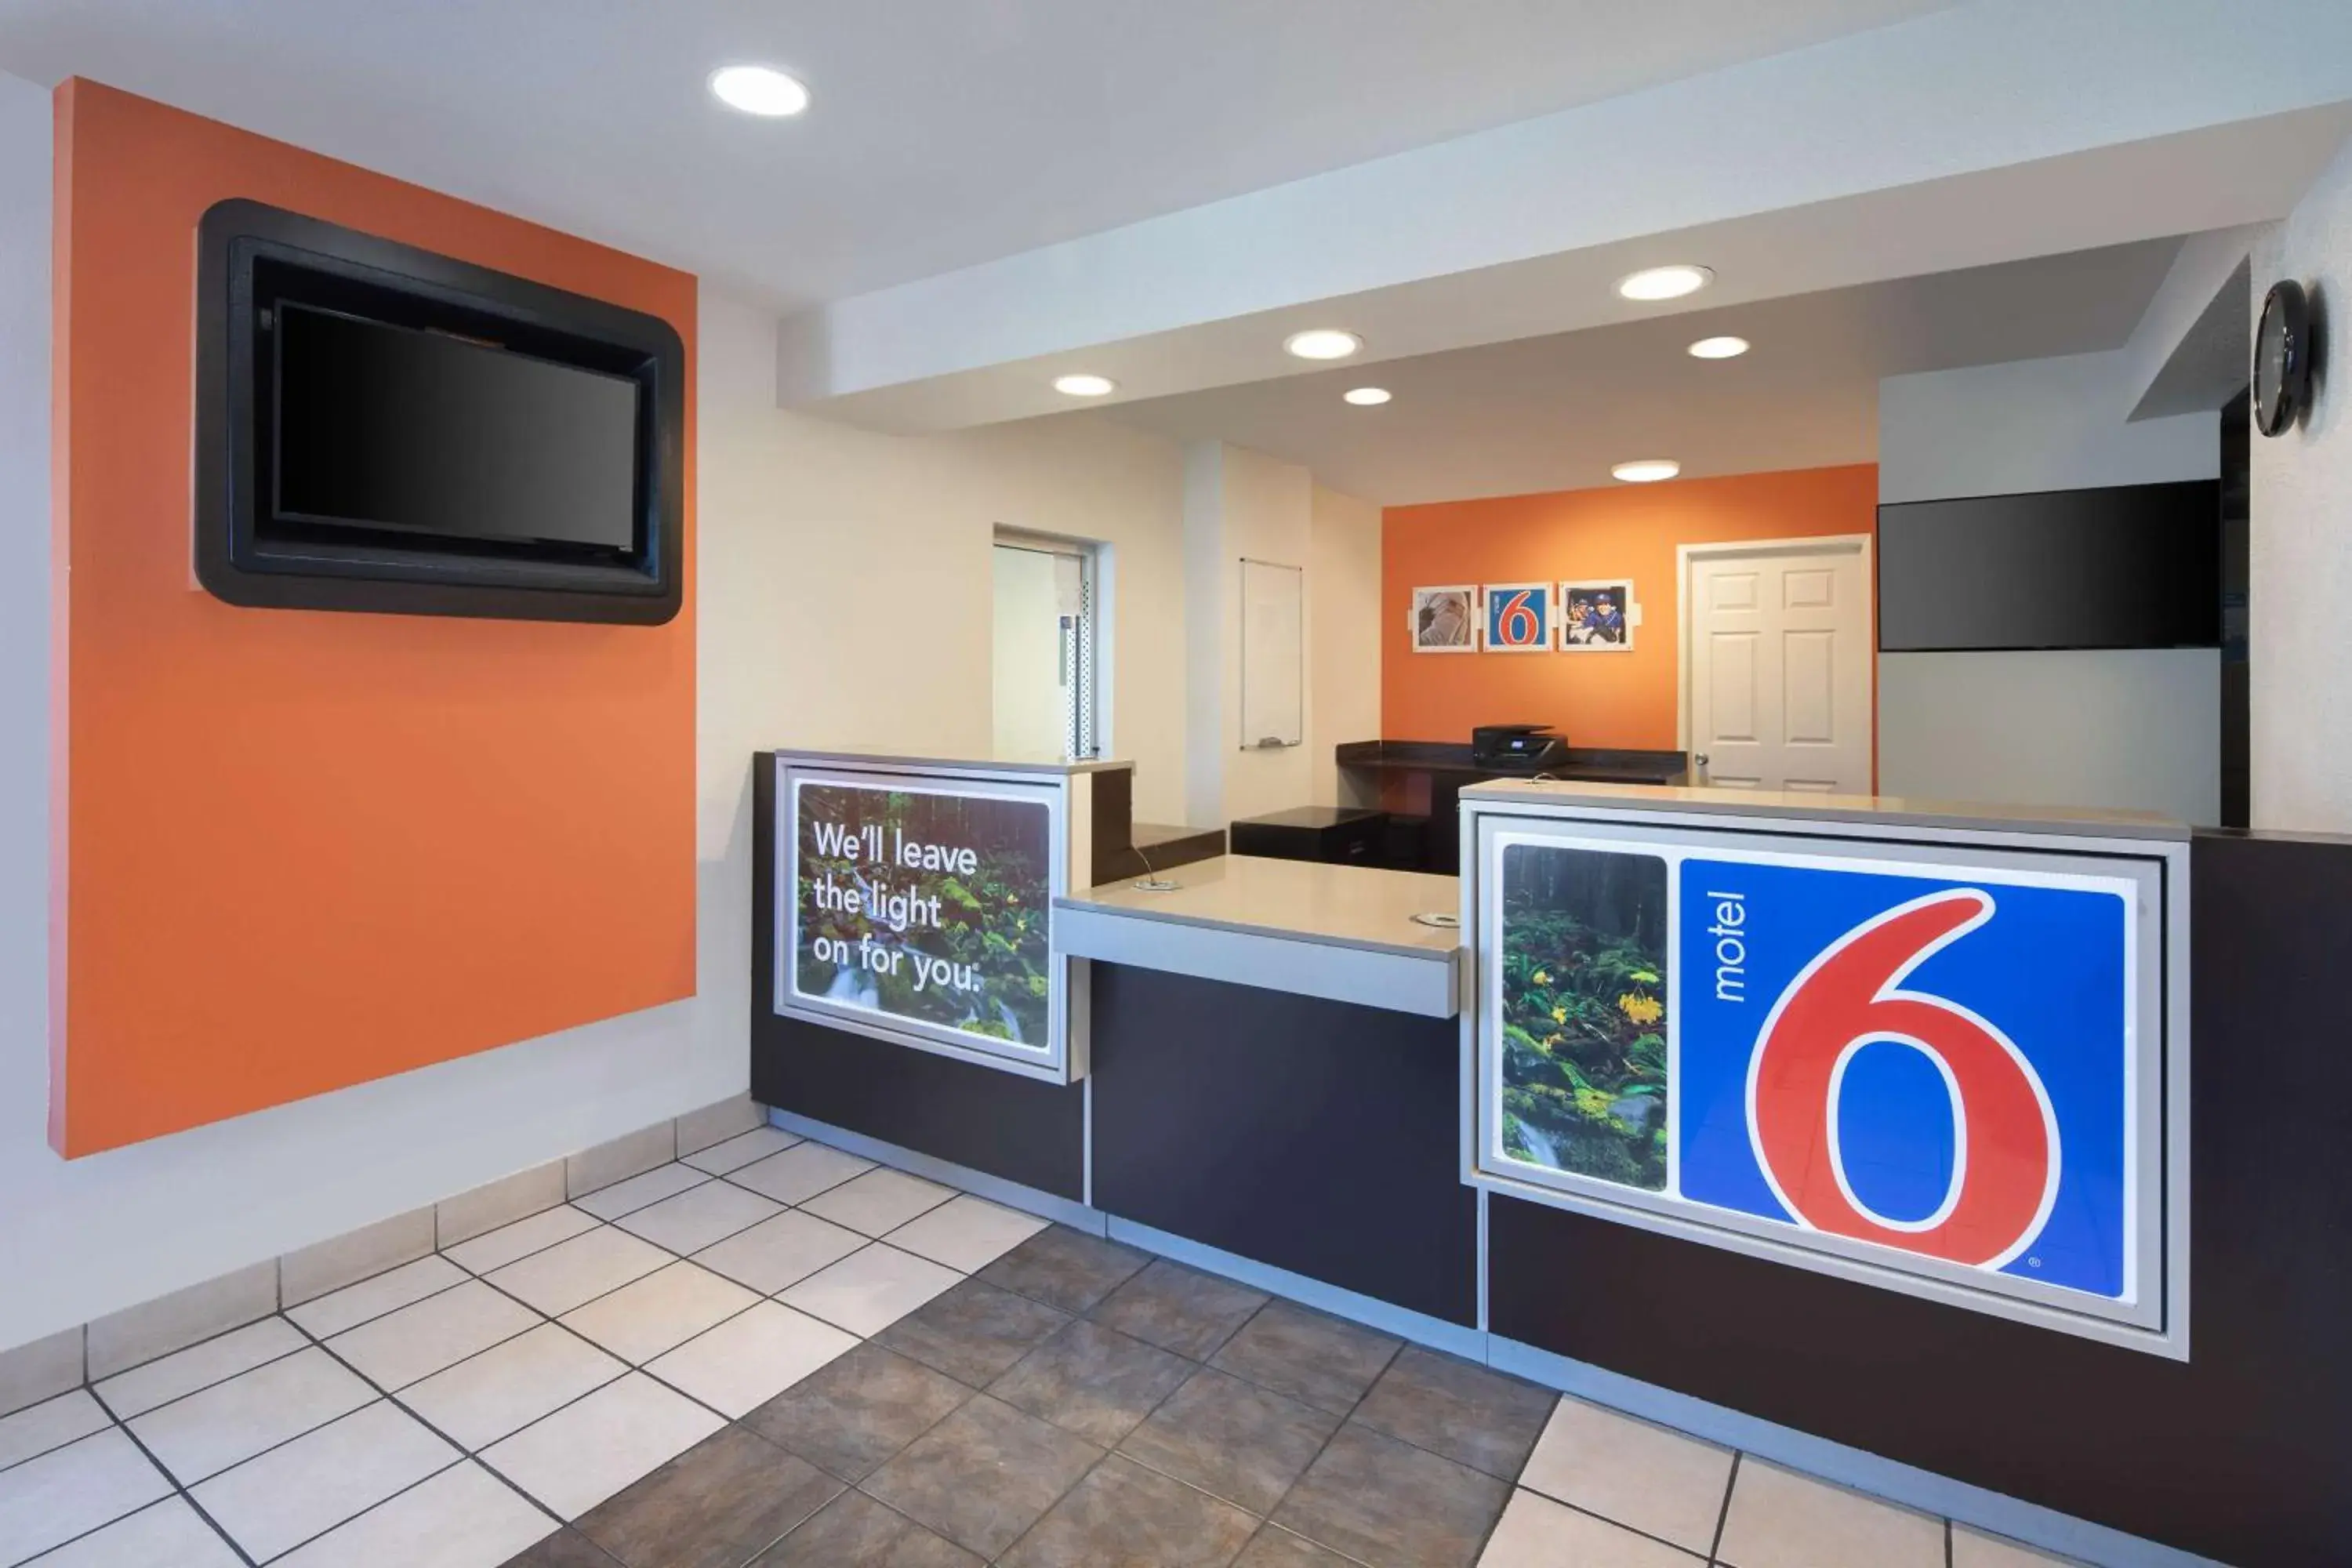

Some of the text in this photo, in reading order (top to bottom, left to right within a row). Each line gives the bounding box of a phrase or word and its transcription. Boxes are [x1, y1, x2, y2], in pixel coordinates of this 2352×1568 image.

[1499, 590, 1539, 645] 6
[813, 822, 978, 875] We'll leave
[813, 873, 941, 932] the light
[814, 937, 848, 965] on
[858, 933, 903, 975] for
[1708, 891, 1745, 1003] motel
[1745, 887, 2061, 1272] 6
